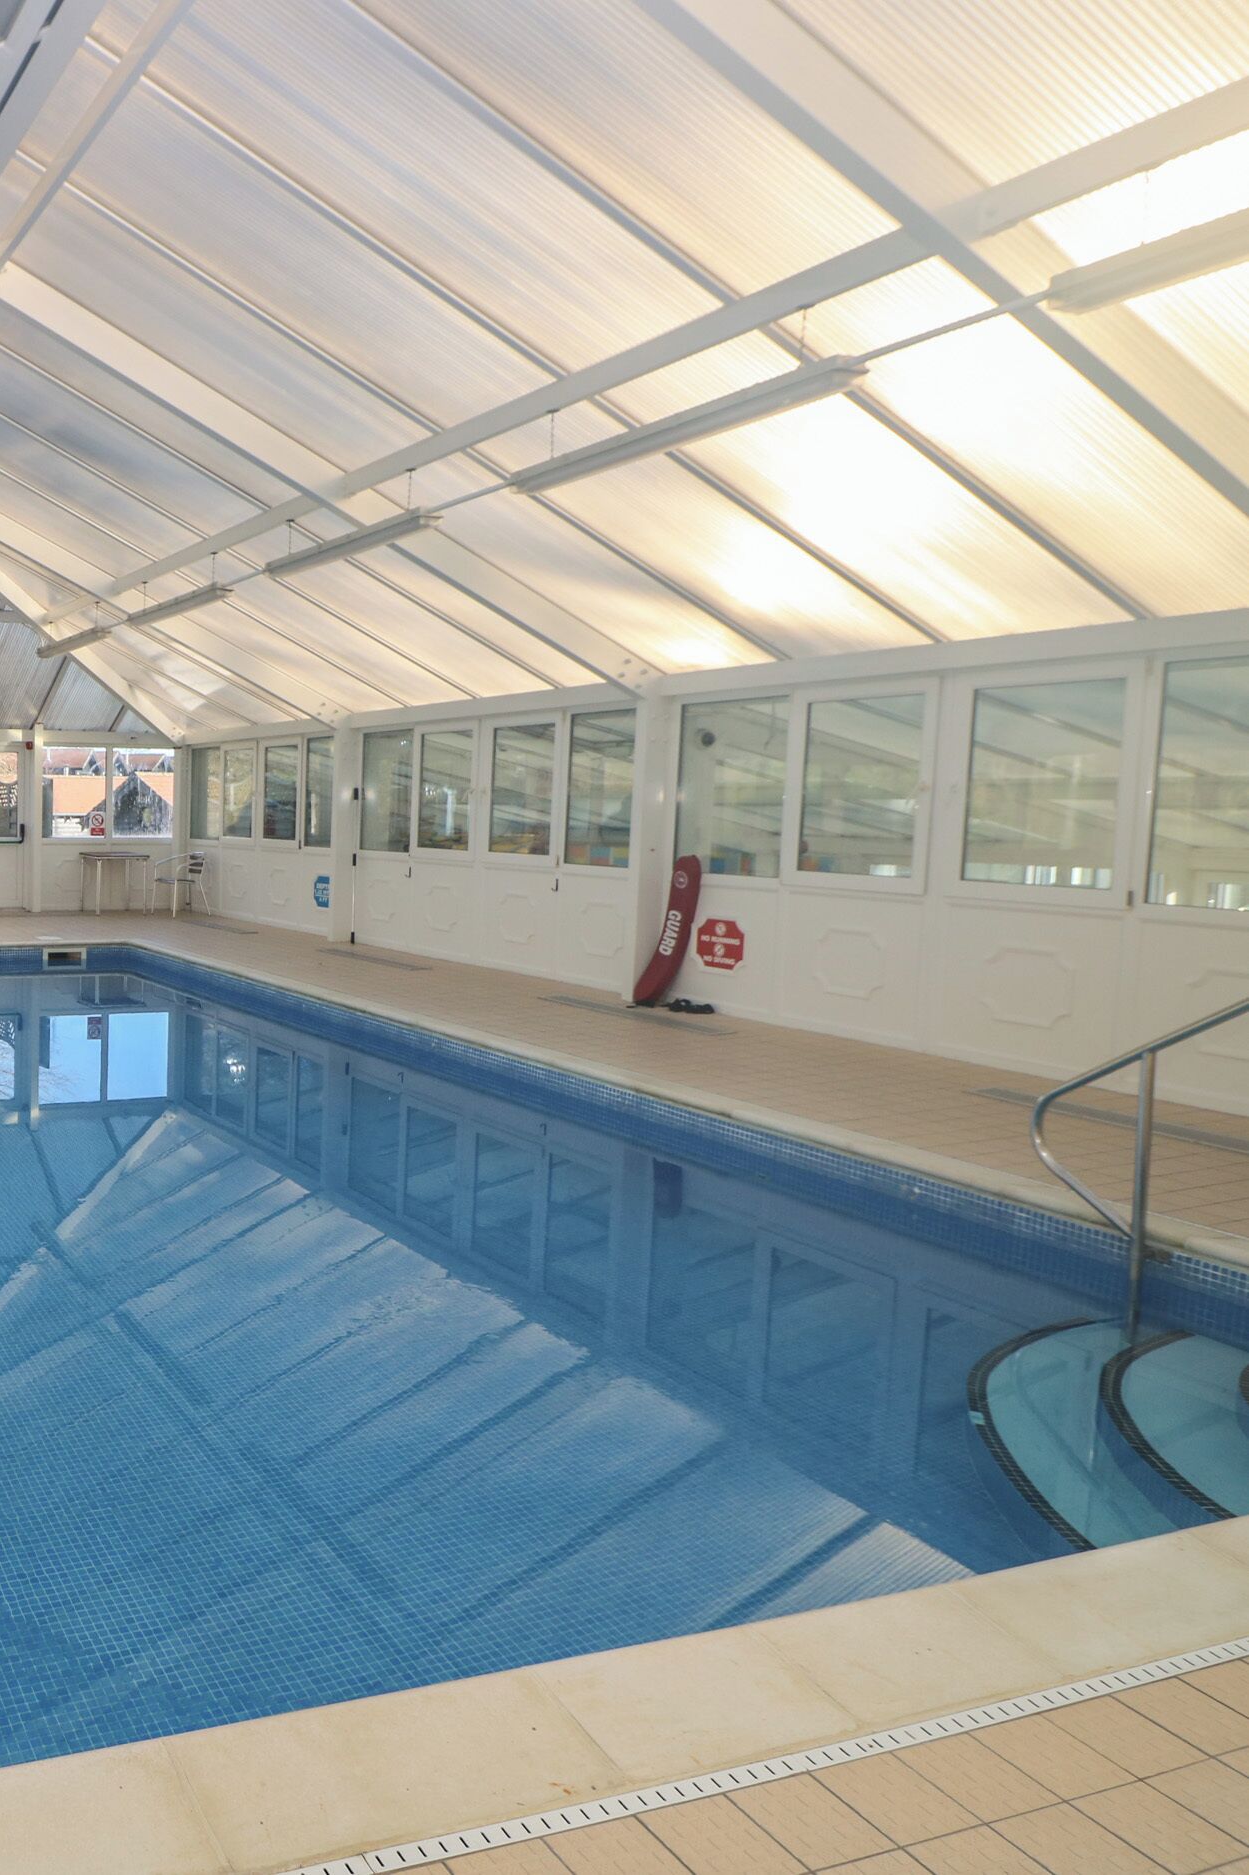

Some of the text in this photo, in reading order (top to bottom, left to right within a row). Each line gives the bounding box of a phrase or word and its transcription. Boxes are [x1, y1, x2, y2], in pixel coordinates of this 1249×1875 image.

[659, 909, 682, 956] GUARD
[711, 935, 740, 946] RUNNING
[713, 956, 736, 966] DIVING
